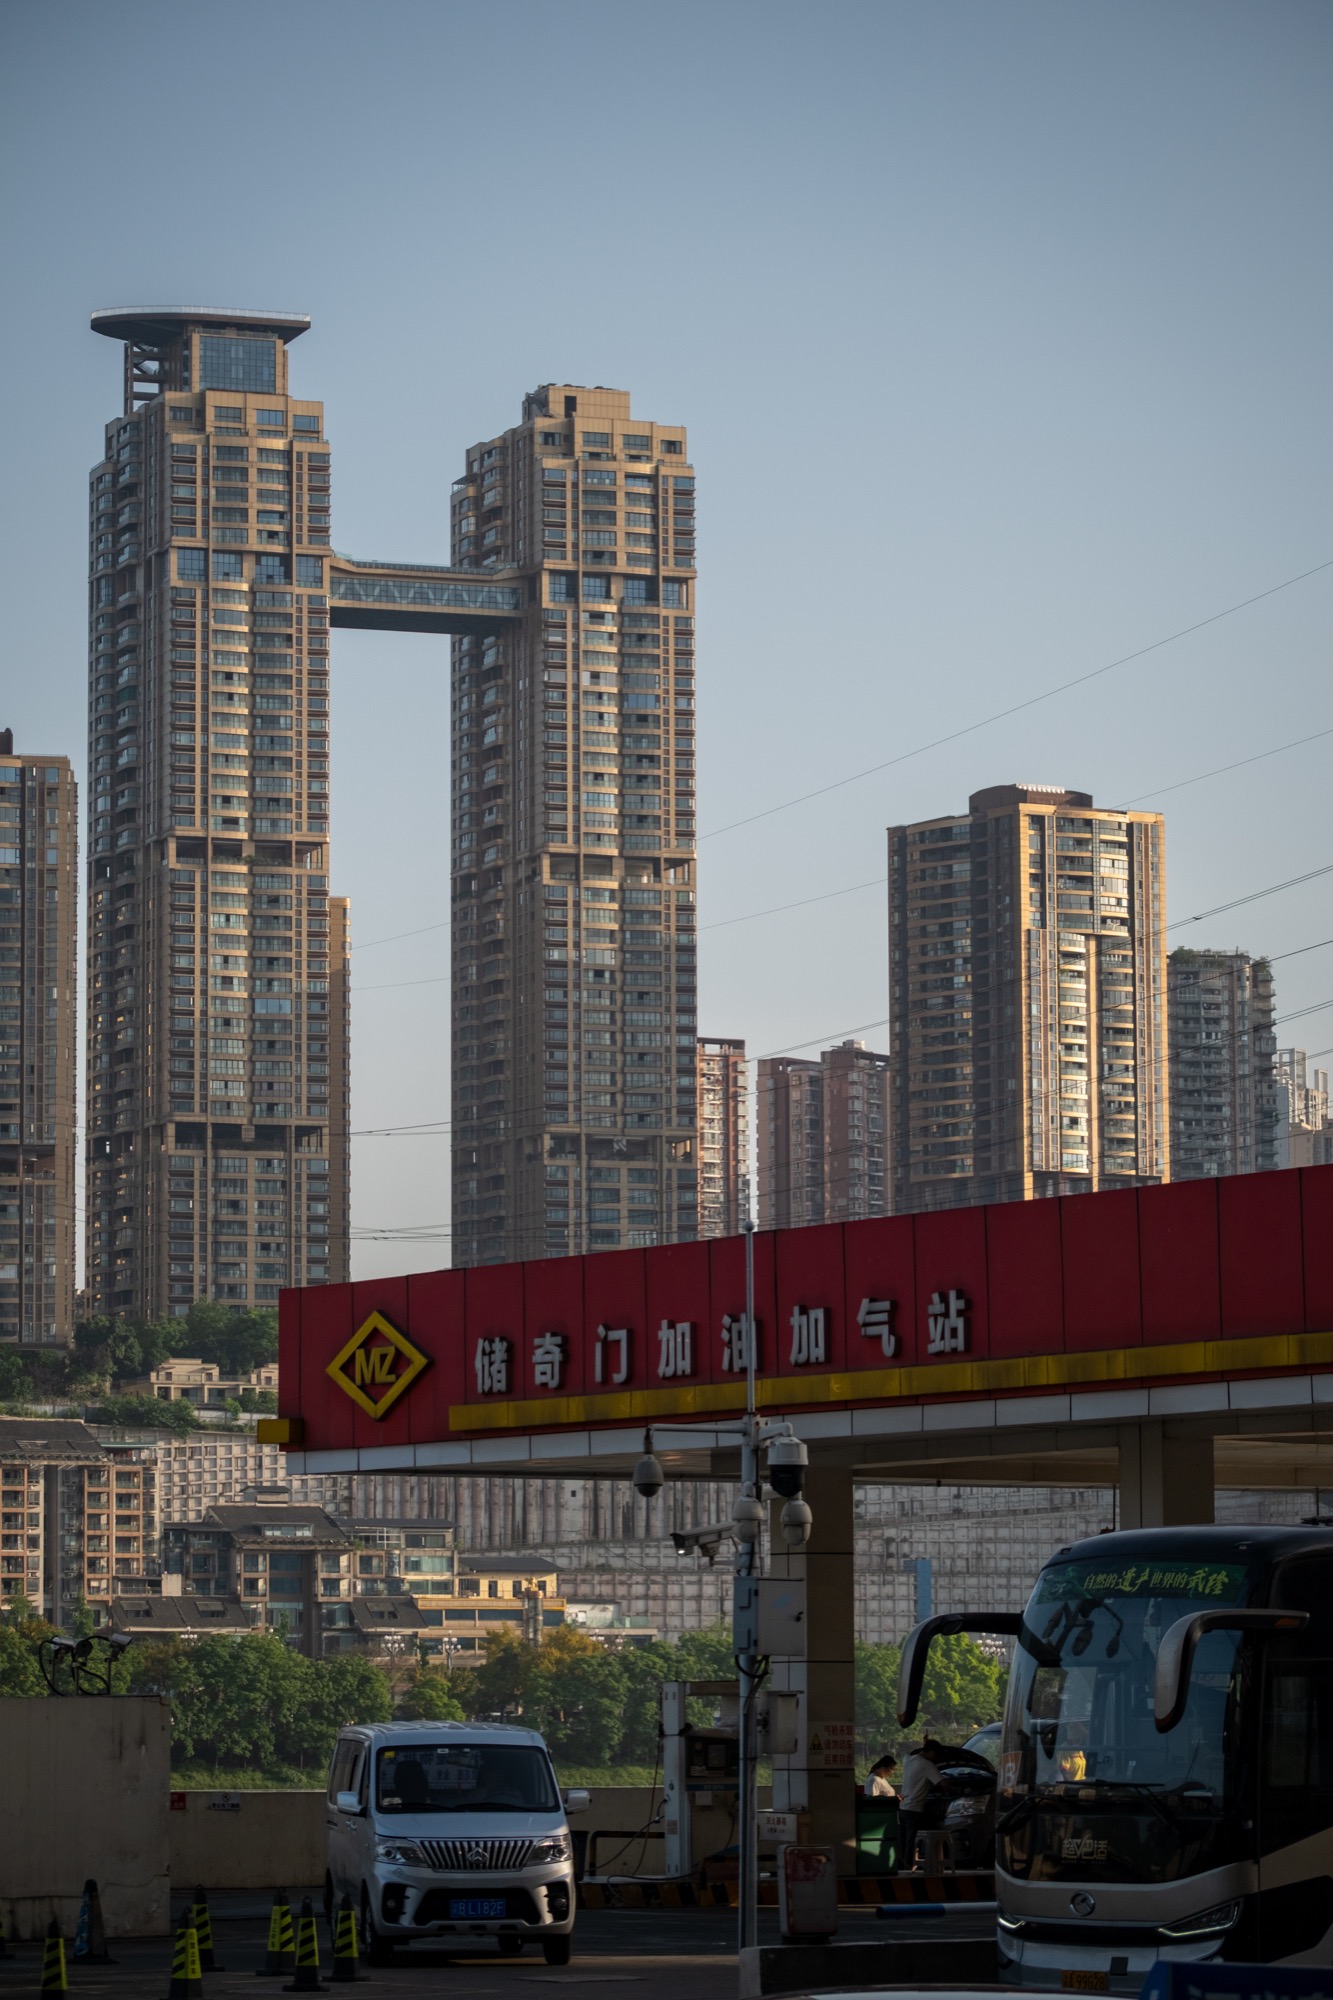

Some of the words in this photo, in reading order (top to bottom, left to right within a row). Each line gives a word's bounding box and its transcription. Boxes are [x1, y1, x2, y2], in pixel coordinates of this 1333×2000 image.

[355, 1346, 396, 1386] MZ
[474, 1289, 970, 1395] 储奇门加油加气站
